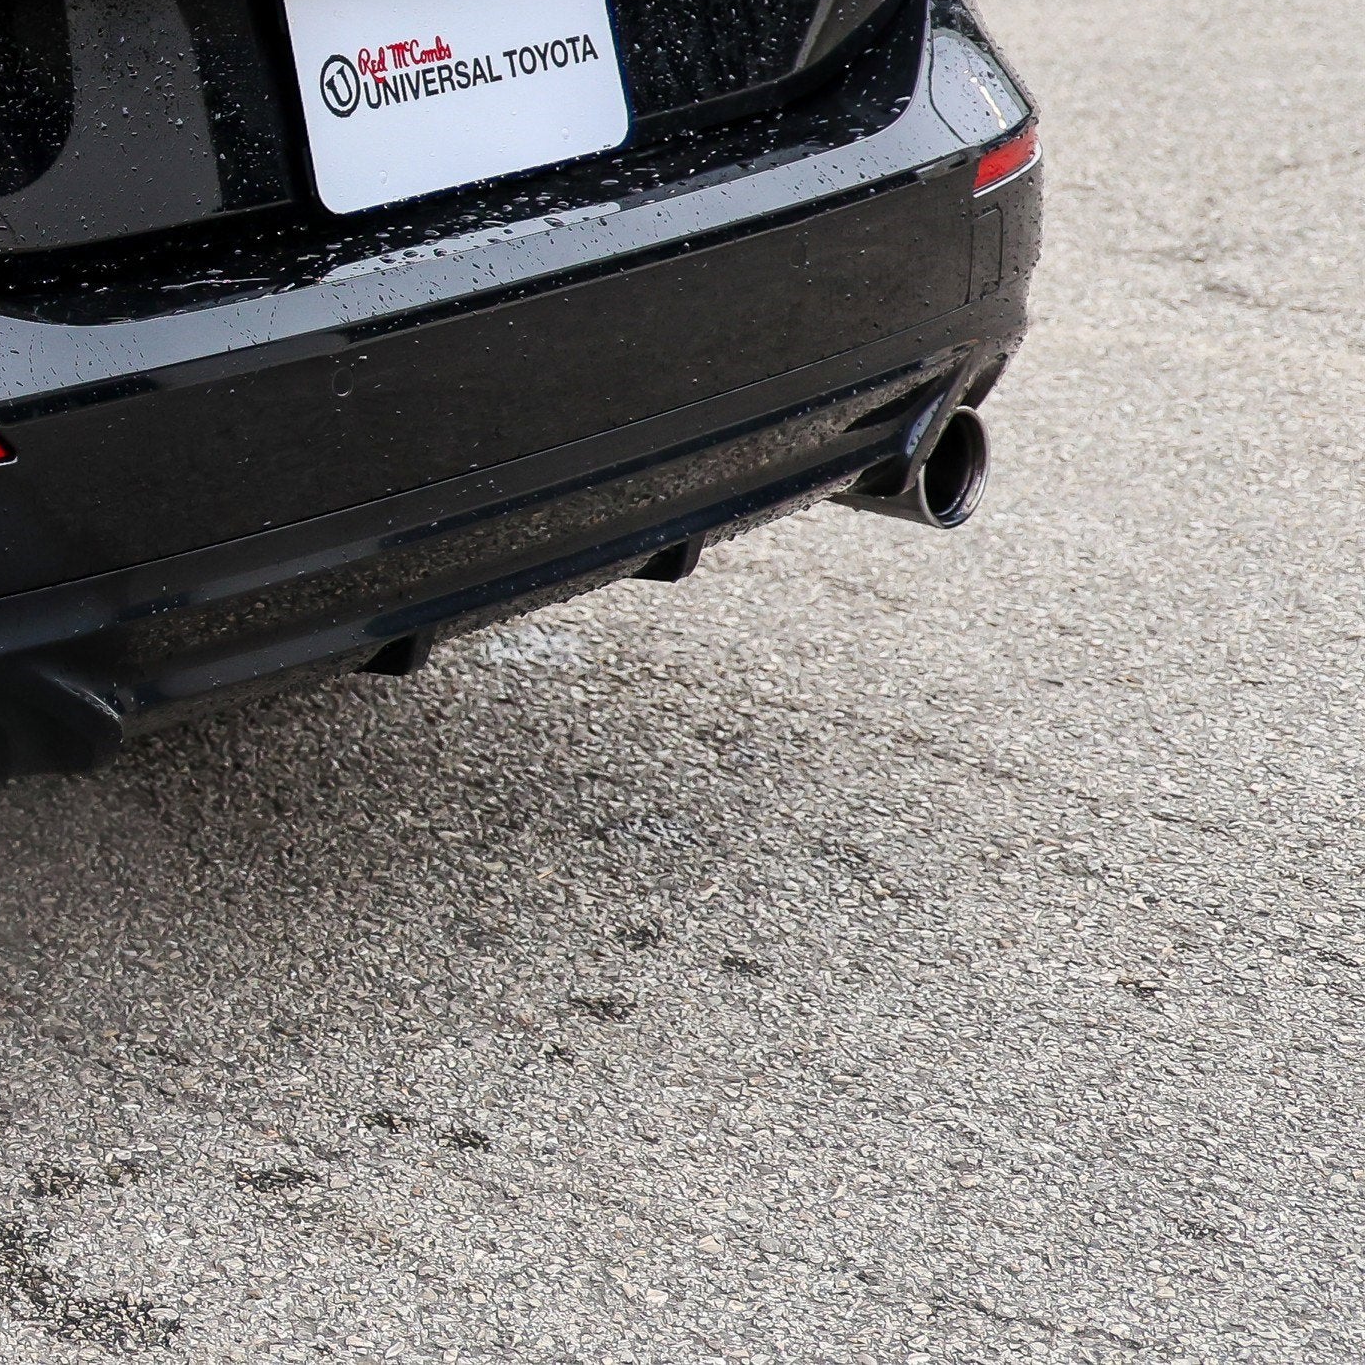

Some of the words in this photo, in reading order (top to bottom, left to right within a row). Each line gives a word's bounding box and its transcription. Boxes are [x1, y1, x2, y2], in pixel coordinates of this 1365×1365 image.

[358, 48, 387, 83] Red
[387, 36, 452, 69] McCombs
[363, 55, 503, 110] UNIVERSAL
[503, 33, 599, 78] TOYOTA
